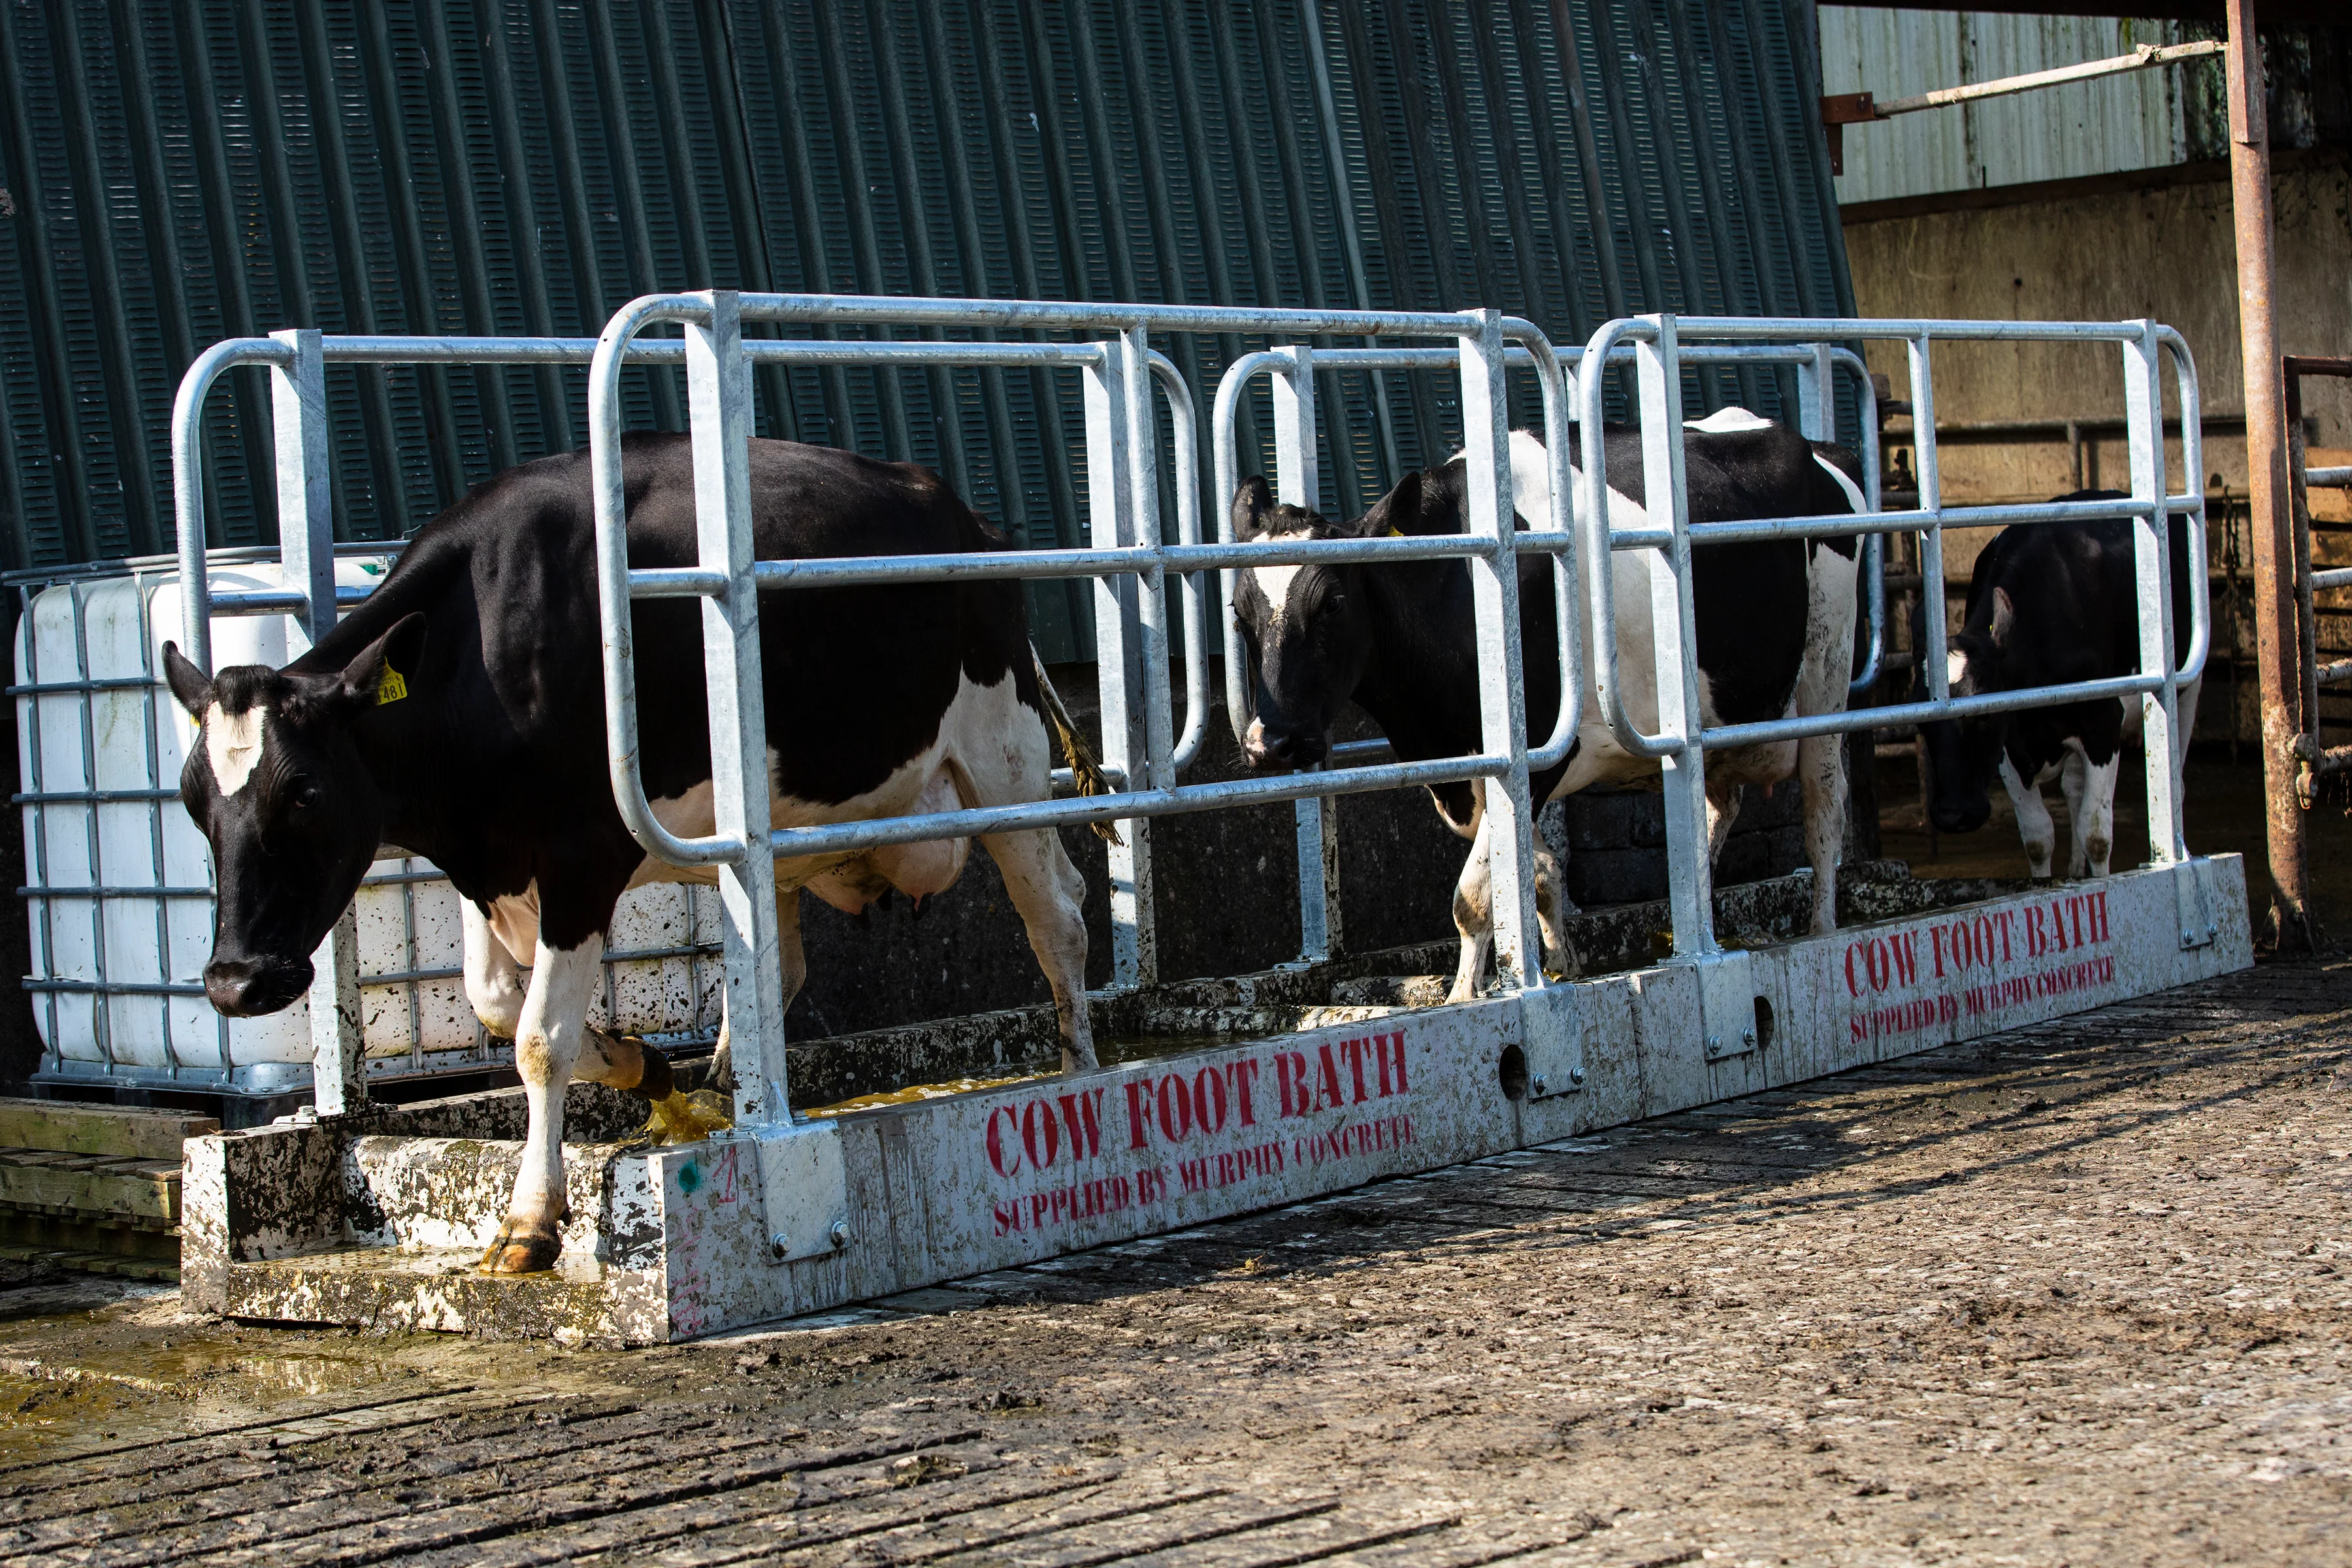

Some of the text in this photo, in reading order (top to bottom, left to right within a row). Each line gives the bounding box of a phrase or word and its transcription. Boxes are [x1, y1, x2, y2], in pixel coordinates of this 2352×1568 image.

[1845, 891, 2110, 998] COW FOOT BATH
[1850, 955, 2115, 1044] SUPPLIED BY MURPHY CONCRETE
[987, 1031, 1410, 1177] COW FOOT BATH
[994, 1114, 1418, 1237] SUPPLIED BY MURPHY CONCRETE
